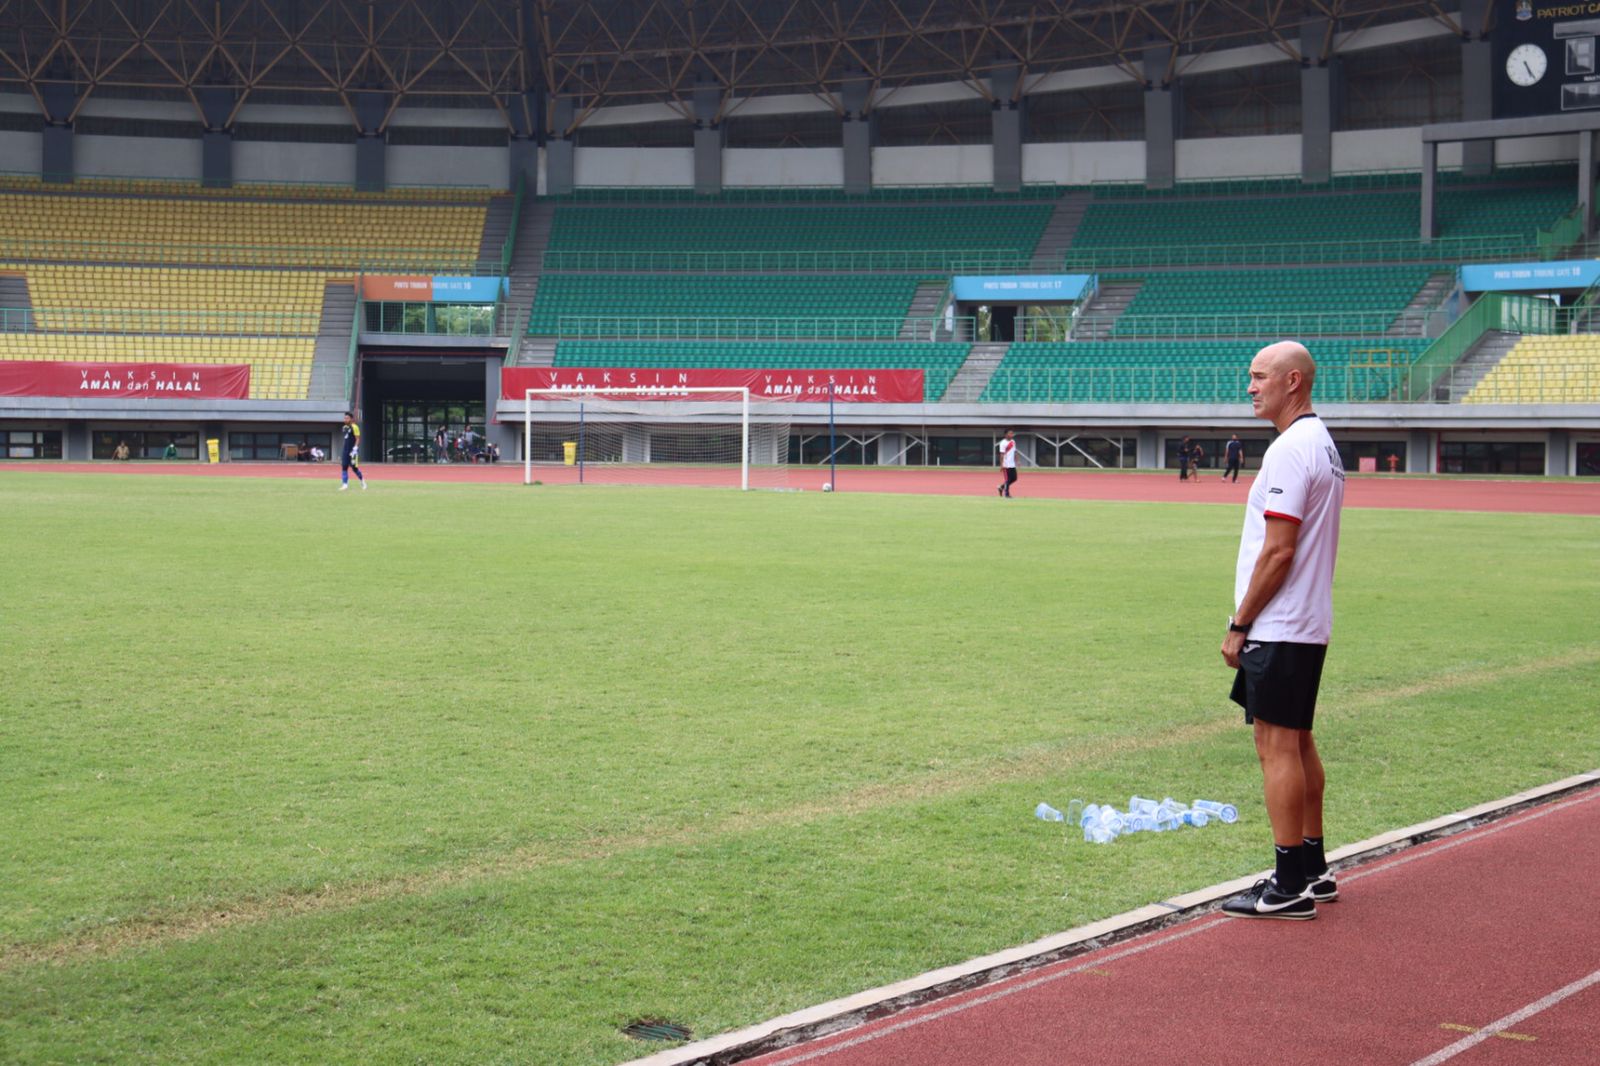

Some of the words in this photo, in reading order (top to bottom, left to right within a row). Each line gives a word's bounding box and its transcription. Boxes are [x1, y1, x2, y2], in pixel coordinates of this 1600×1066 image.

[1537, 4, 1586, 18] PATRIOT
[80, 380, 121, 390] AMAN
[127, 381, 149, 390] dan
[155, 380, 201, 391] HALAL
[764, 385, 802, 395] AMAN
[807, 385, 828, 394] dan
[834, 385, 877, 395] HALAL
